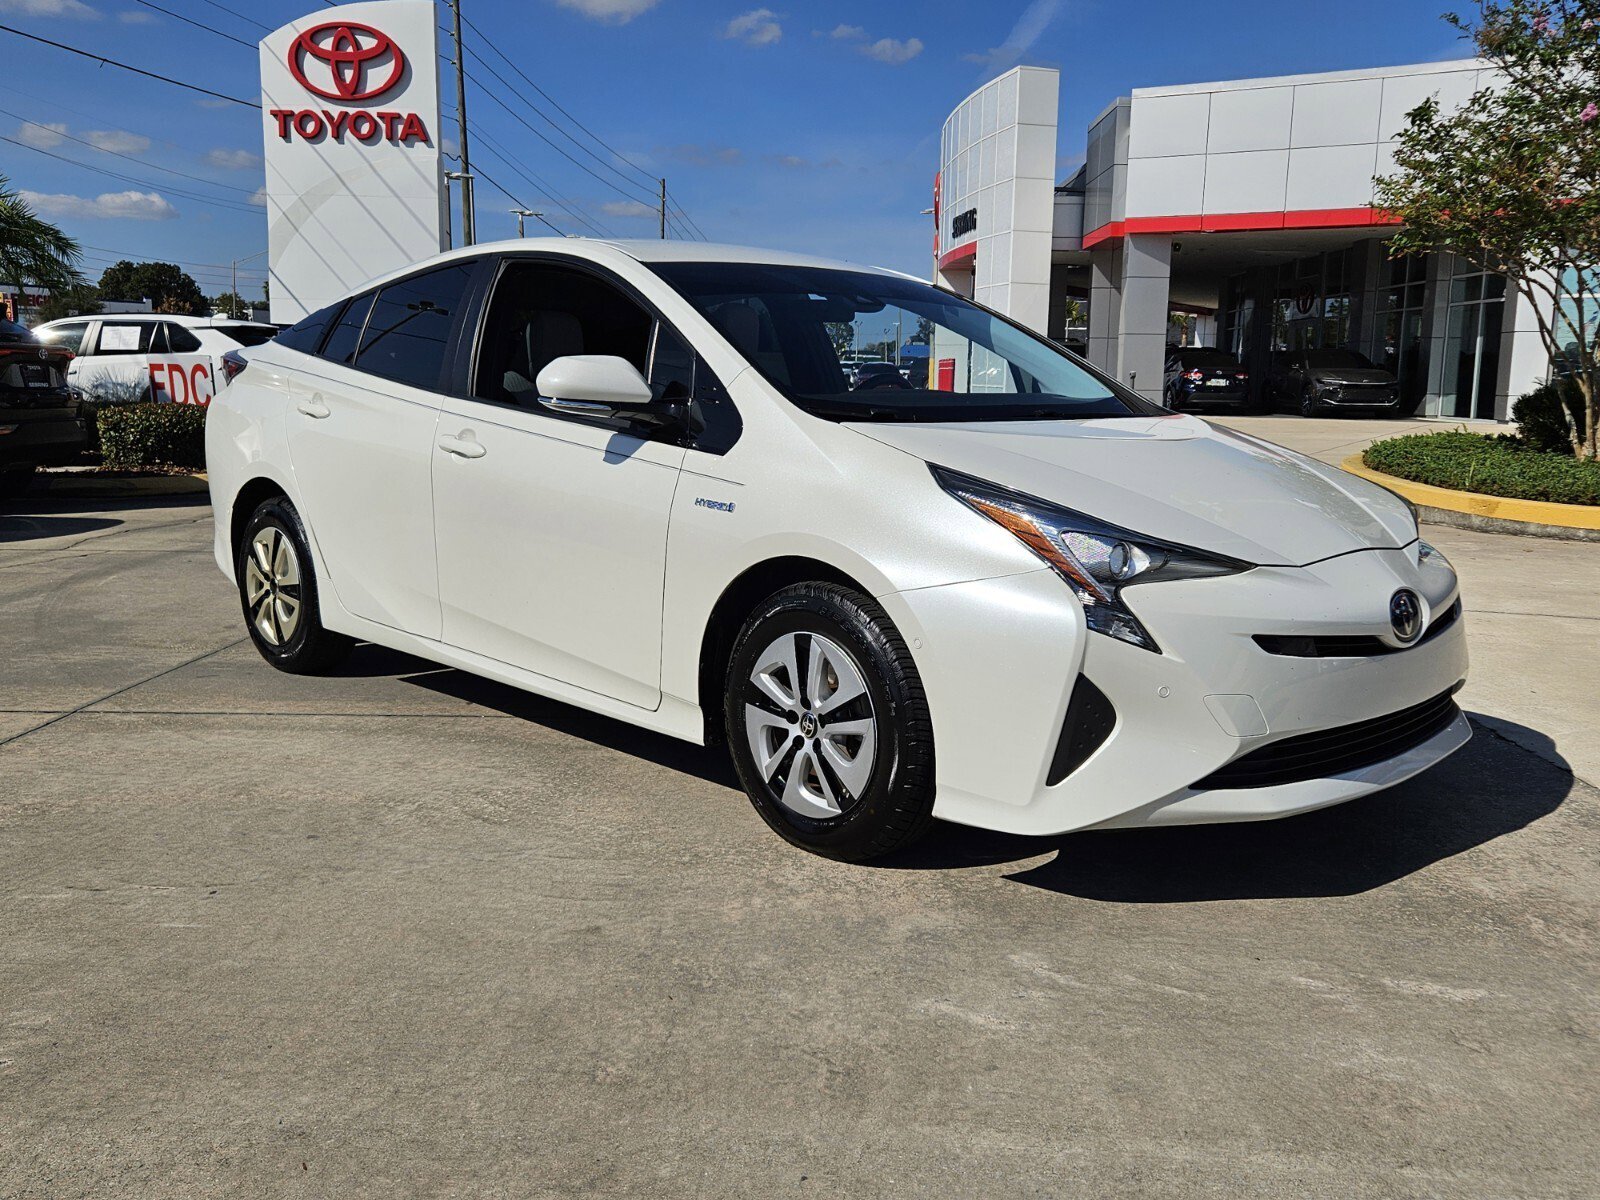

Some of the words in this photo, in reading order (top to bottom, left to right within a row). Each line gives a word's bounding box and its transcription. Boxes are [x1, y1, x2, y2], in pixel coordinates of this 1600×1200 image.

[270, 109, 428, 142] TOYOTA
[149, 363, 211, 406] FDC
[694, 497, 728, 511] HYBRID
